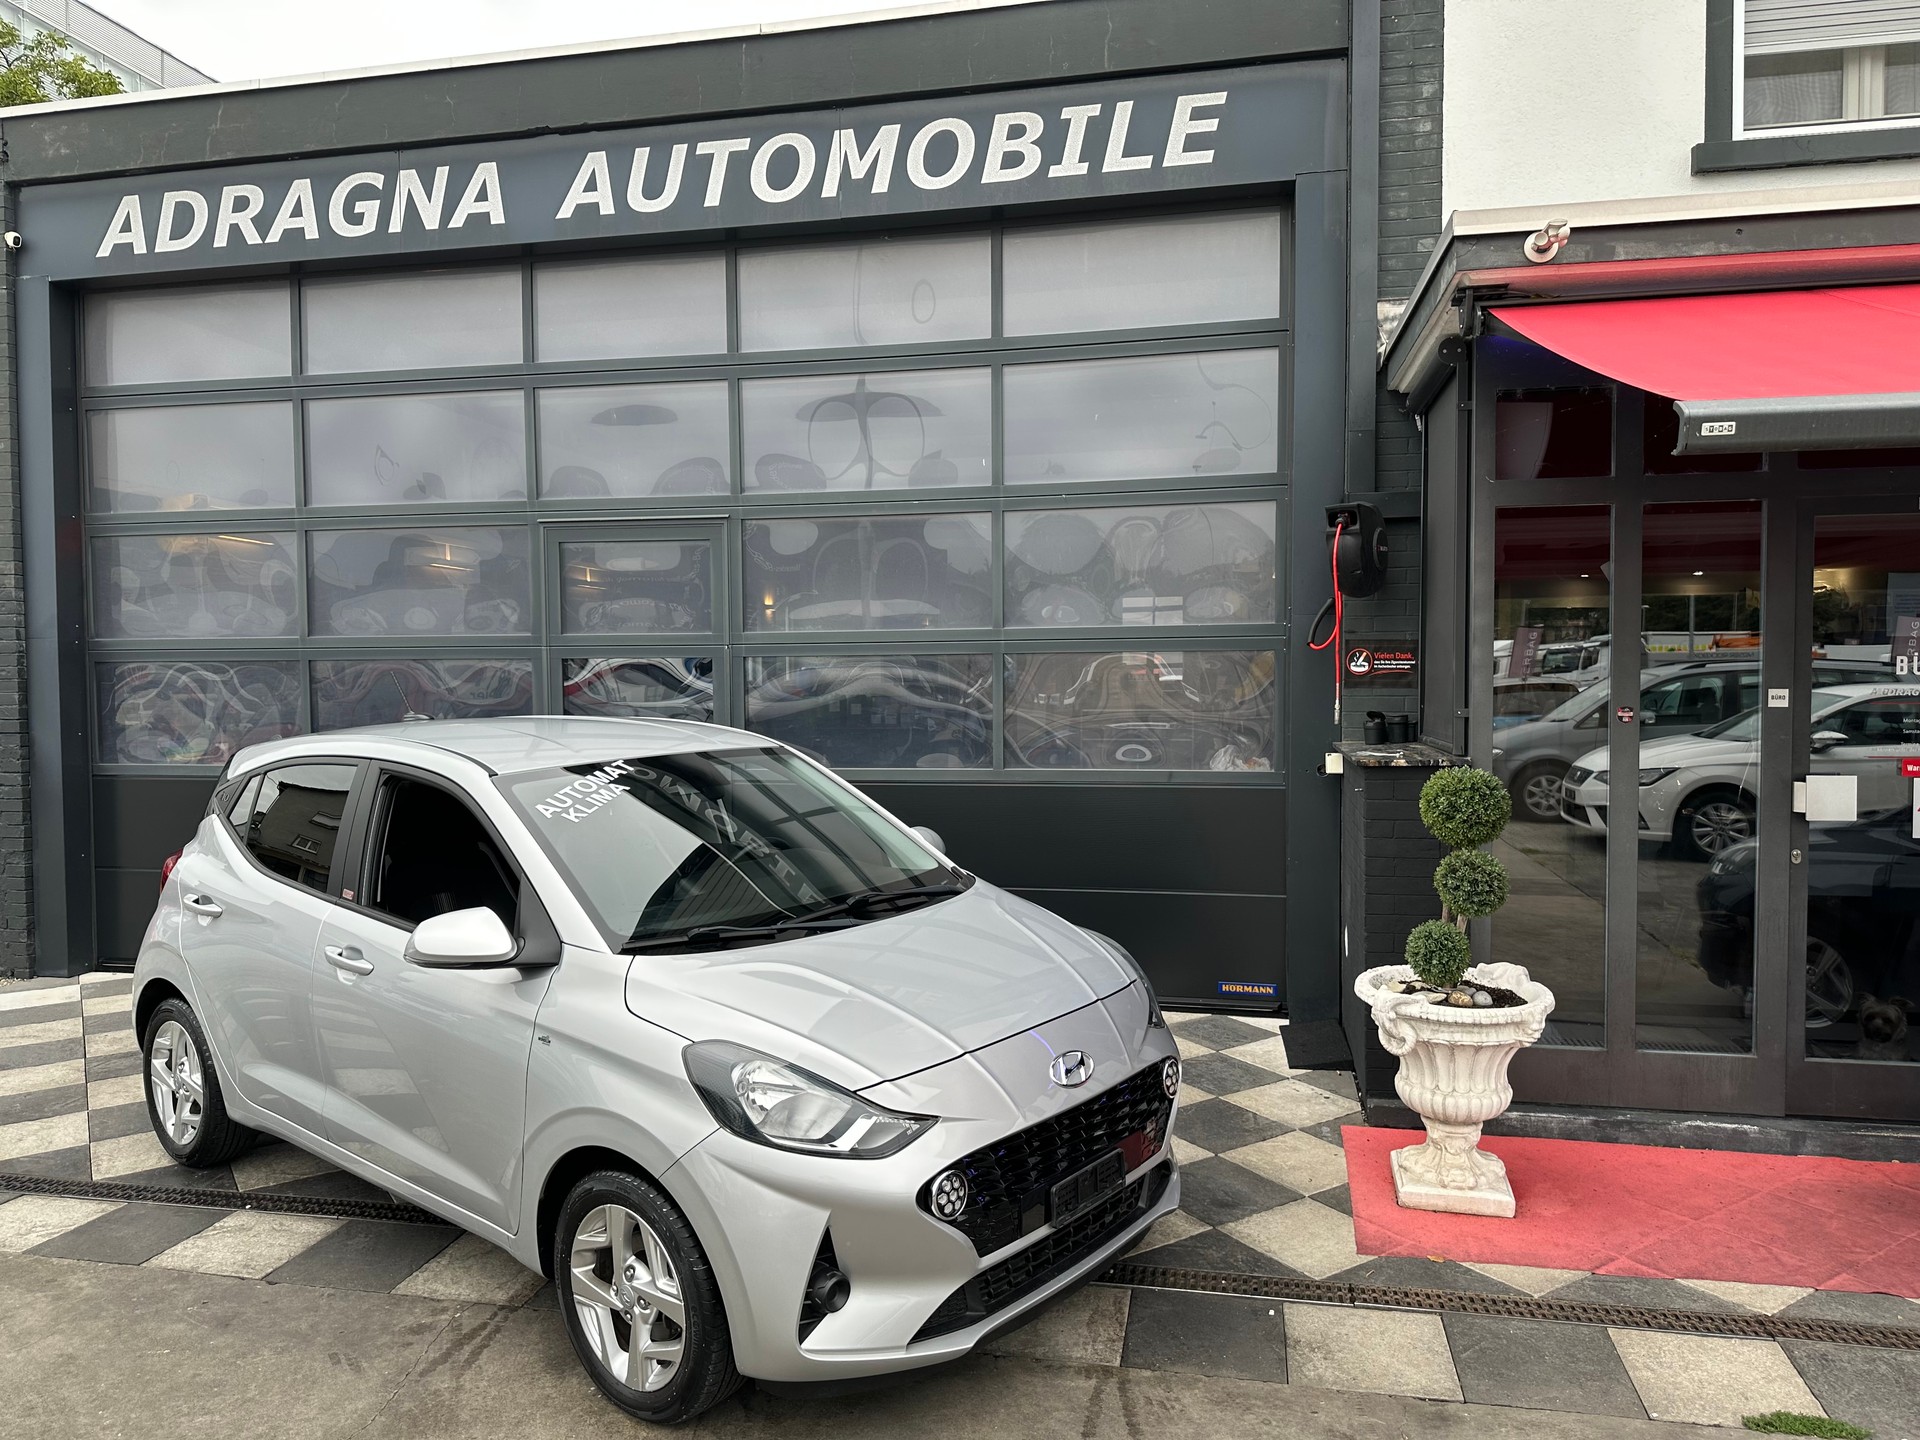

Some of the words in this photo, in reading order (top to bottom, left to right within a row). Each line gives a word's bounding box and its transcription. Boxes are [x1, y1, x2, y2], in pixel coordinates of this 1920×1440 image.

[96, 161, 506, 258] ADRAGNA
[555, 91, 1228, 219] AUTOMOBILE
[535, 759, 634, 819] AUTOMAT
[561, 782, 631, 823] KLIMA
